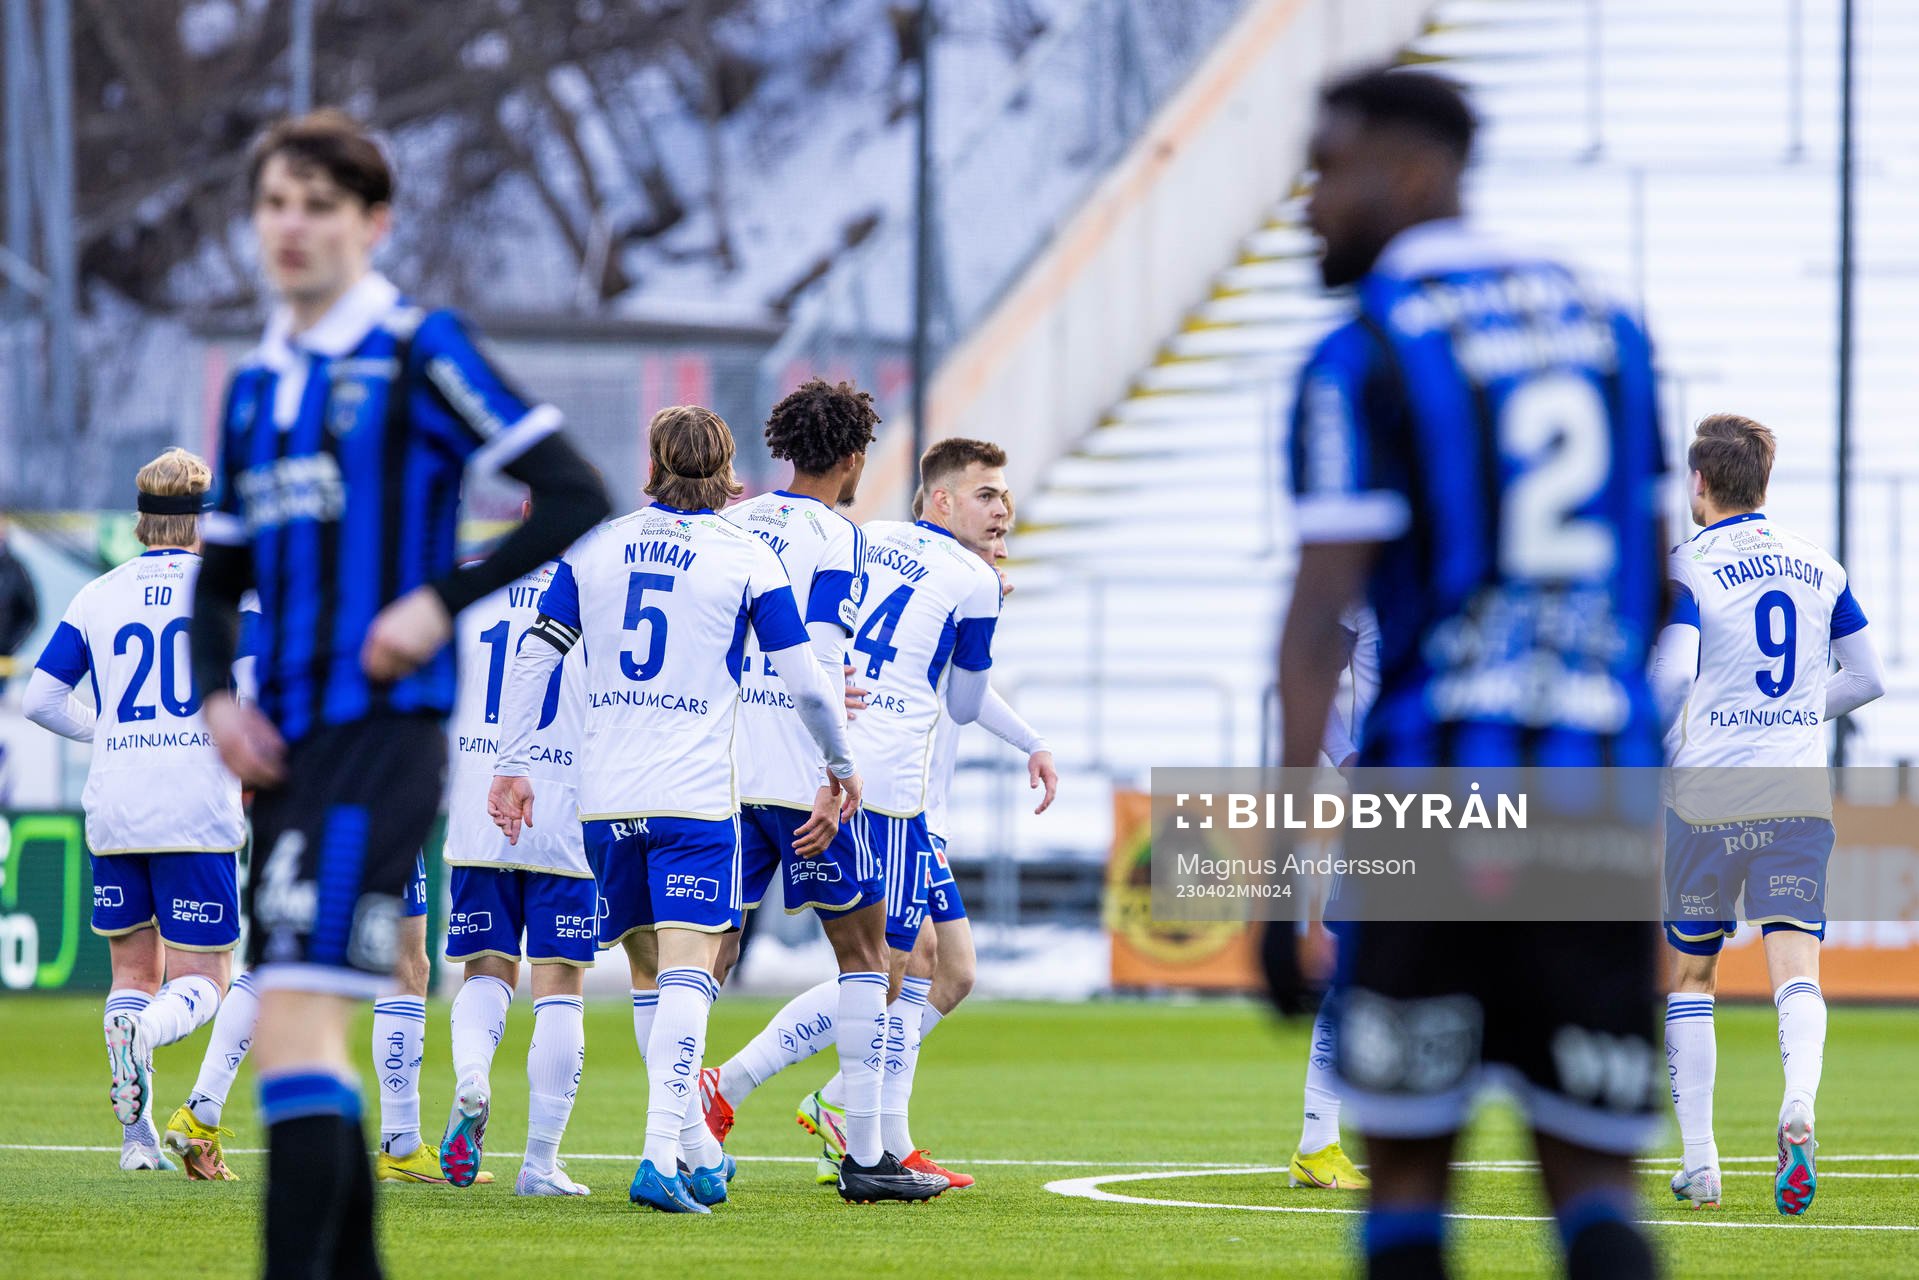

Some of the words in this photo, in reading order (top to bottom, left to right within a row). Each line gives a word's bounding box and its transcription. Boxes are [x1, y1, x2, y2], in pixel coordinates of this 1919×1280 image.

[624, 540, 697, 572] NYMAN
[1712, 554, 1824, 591] TRAUSTASON
[144, 586, 173, 606] EID
[619, 571, 676, 682] 5
[1755, 590, 1797, 699] 9
[106, 731, 219, 752] PLATINUMCAR
[790, 859, 818, 874] pre
[666, 873, 696, 887] pre
[791, 870, 829, 886] zero
[1769, 874, 1798, 888] pre
[414, 881, 427, 905] 19
[665, 886, 705, 901] zero
[935, 889, 949, 912] 3
[1769, 886, 1805, 899] zero
[172, 898, 201, 911] pre
[172, 909, 209, 923] zero
[556, 914, 582, 927] pre
[903, 906, 923, 929] 24
[556, 927, 592, 939] zero
[795, 1012, 833, 1041] Ocab
[384, 1031, 405, 1071] Ocab
[672, 1036, 697, 1077] Ocab
